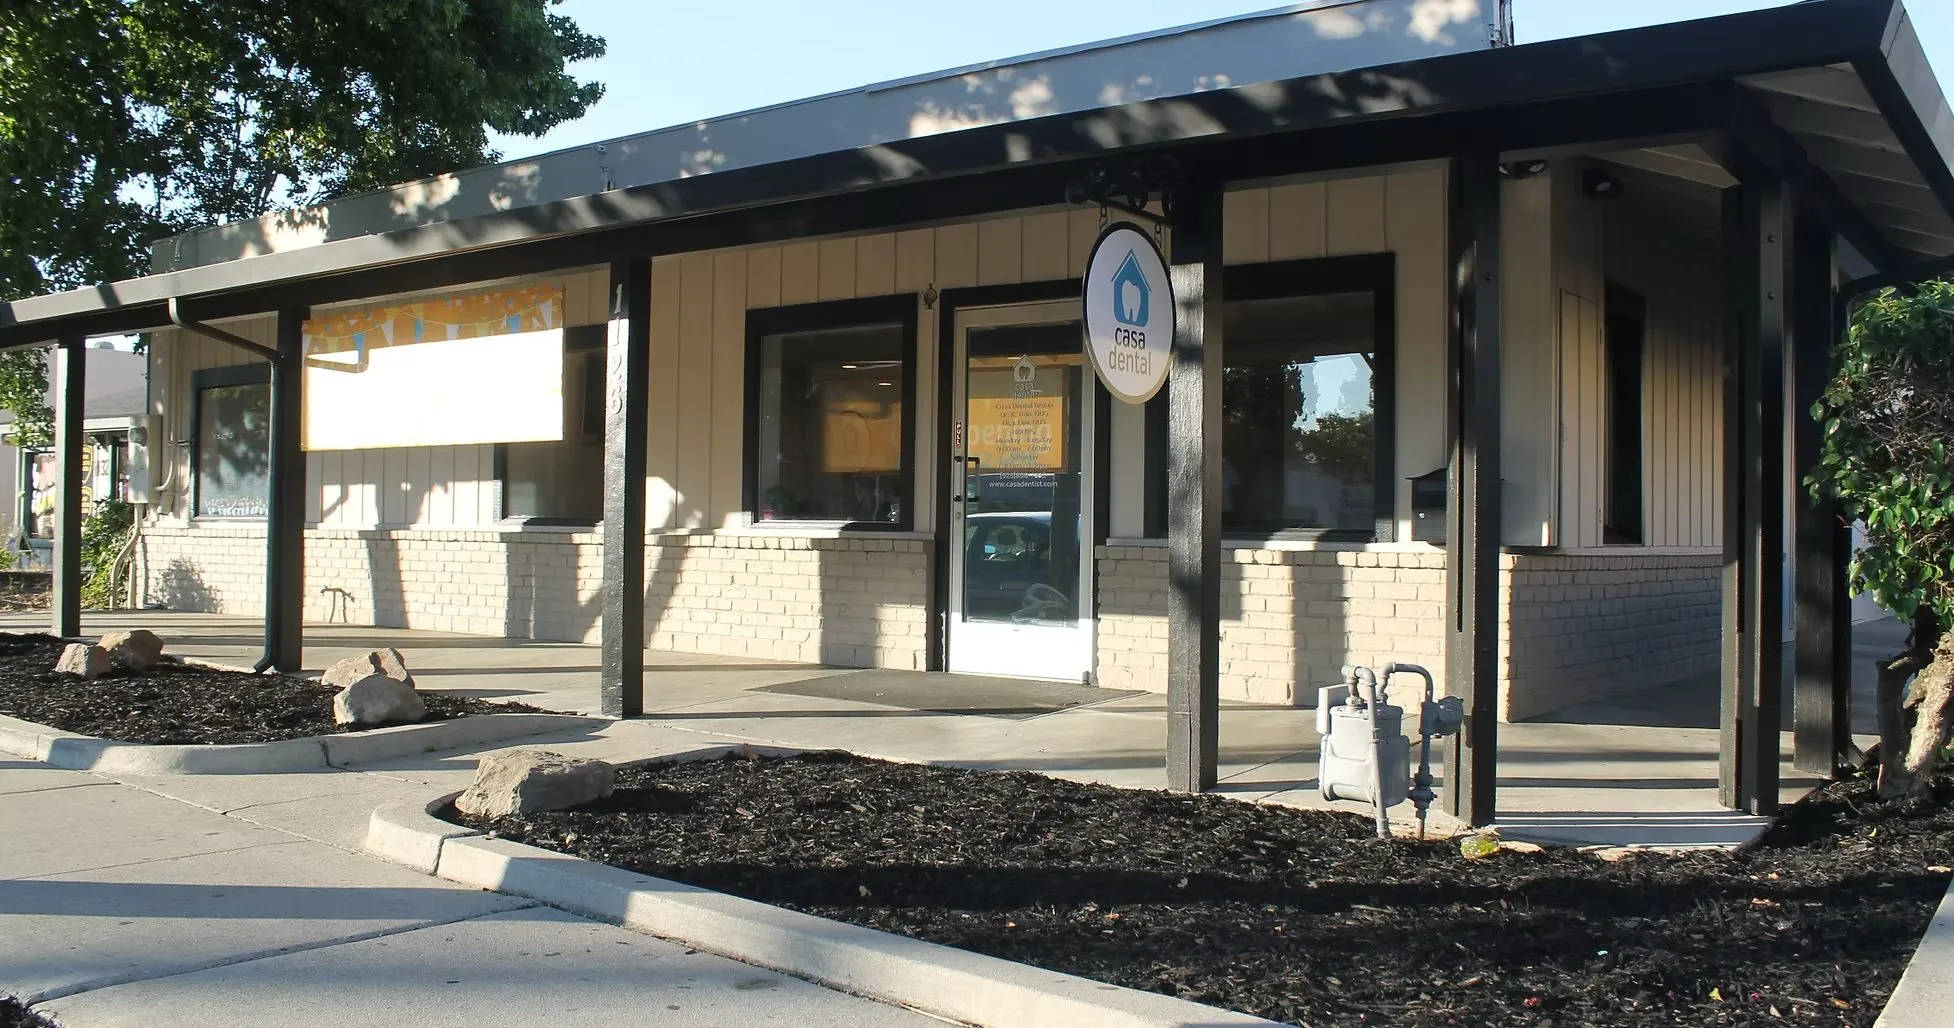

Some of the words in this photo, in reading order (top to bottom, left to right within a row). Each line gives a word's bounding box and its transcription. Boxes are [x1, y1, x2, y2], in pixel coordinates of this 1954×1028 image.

[1115, 327, 1146, 350] casa
[1108, 345, 1152, 376] dental
[989, 480, 1058, 488] www.casadentist.com
